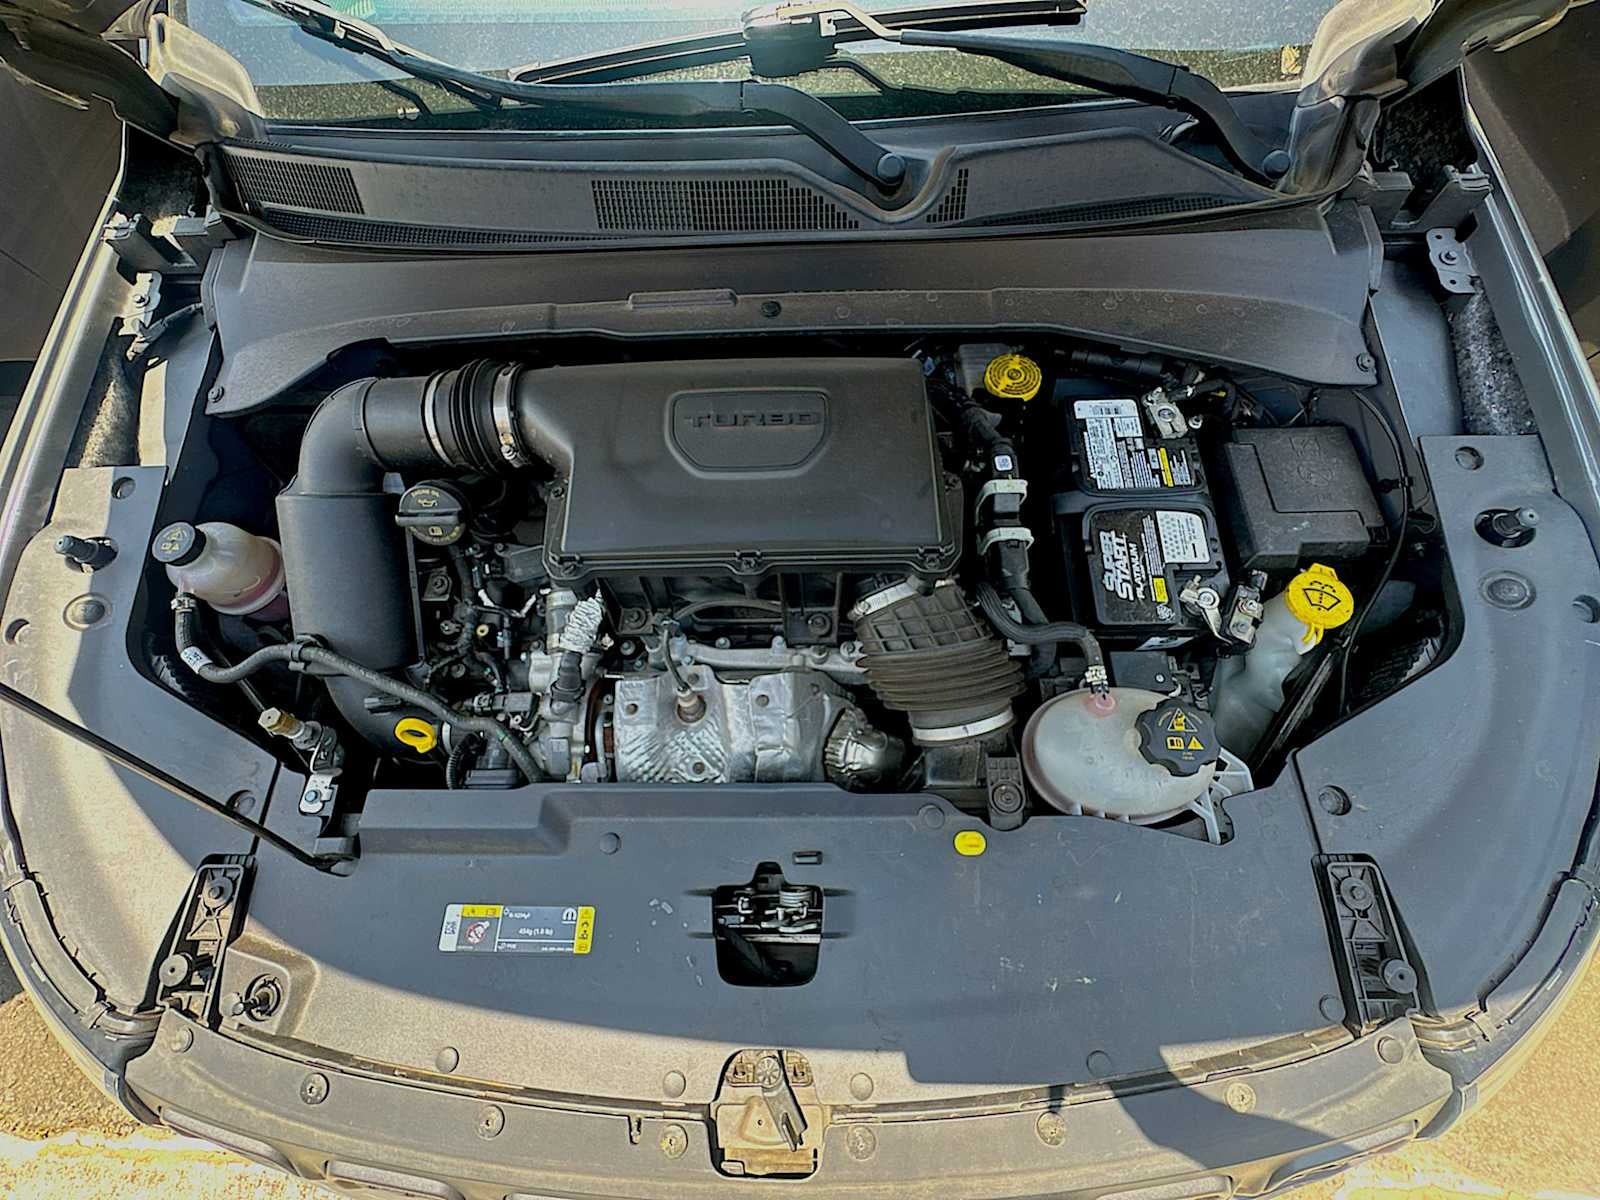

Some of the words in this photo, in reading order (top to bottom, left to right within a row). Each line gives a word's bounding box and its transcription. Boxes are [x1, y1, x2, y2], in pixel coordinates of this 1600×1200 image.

[684, 411, 822, 429] TURBO
[1100, 530, 1117, 592] SUPER
[1112, 532, 1134, 601] START
[1129, 543, 1146, 600] PLATINUM
